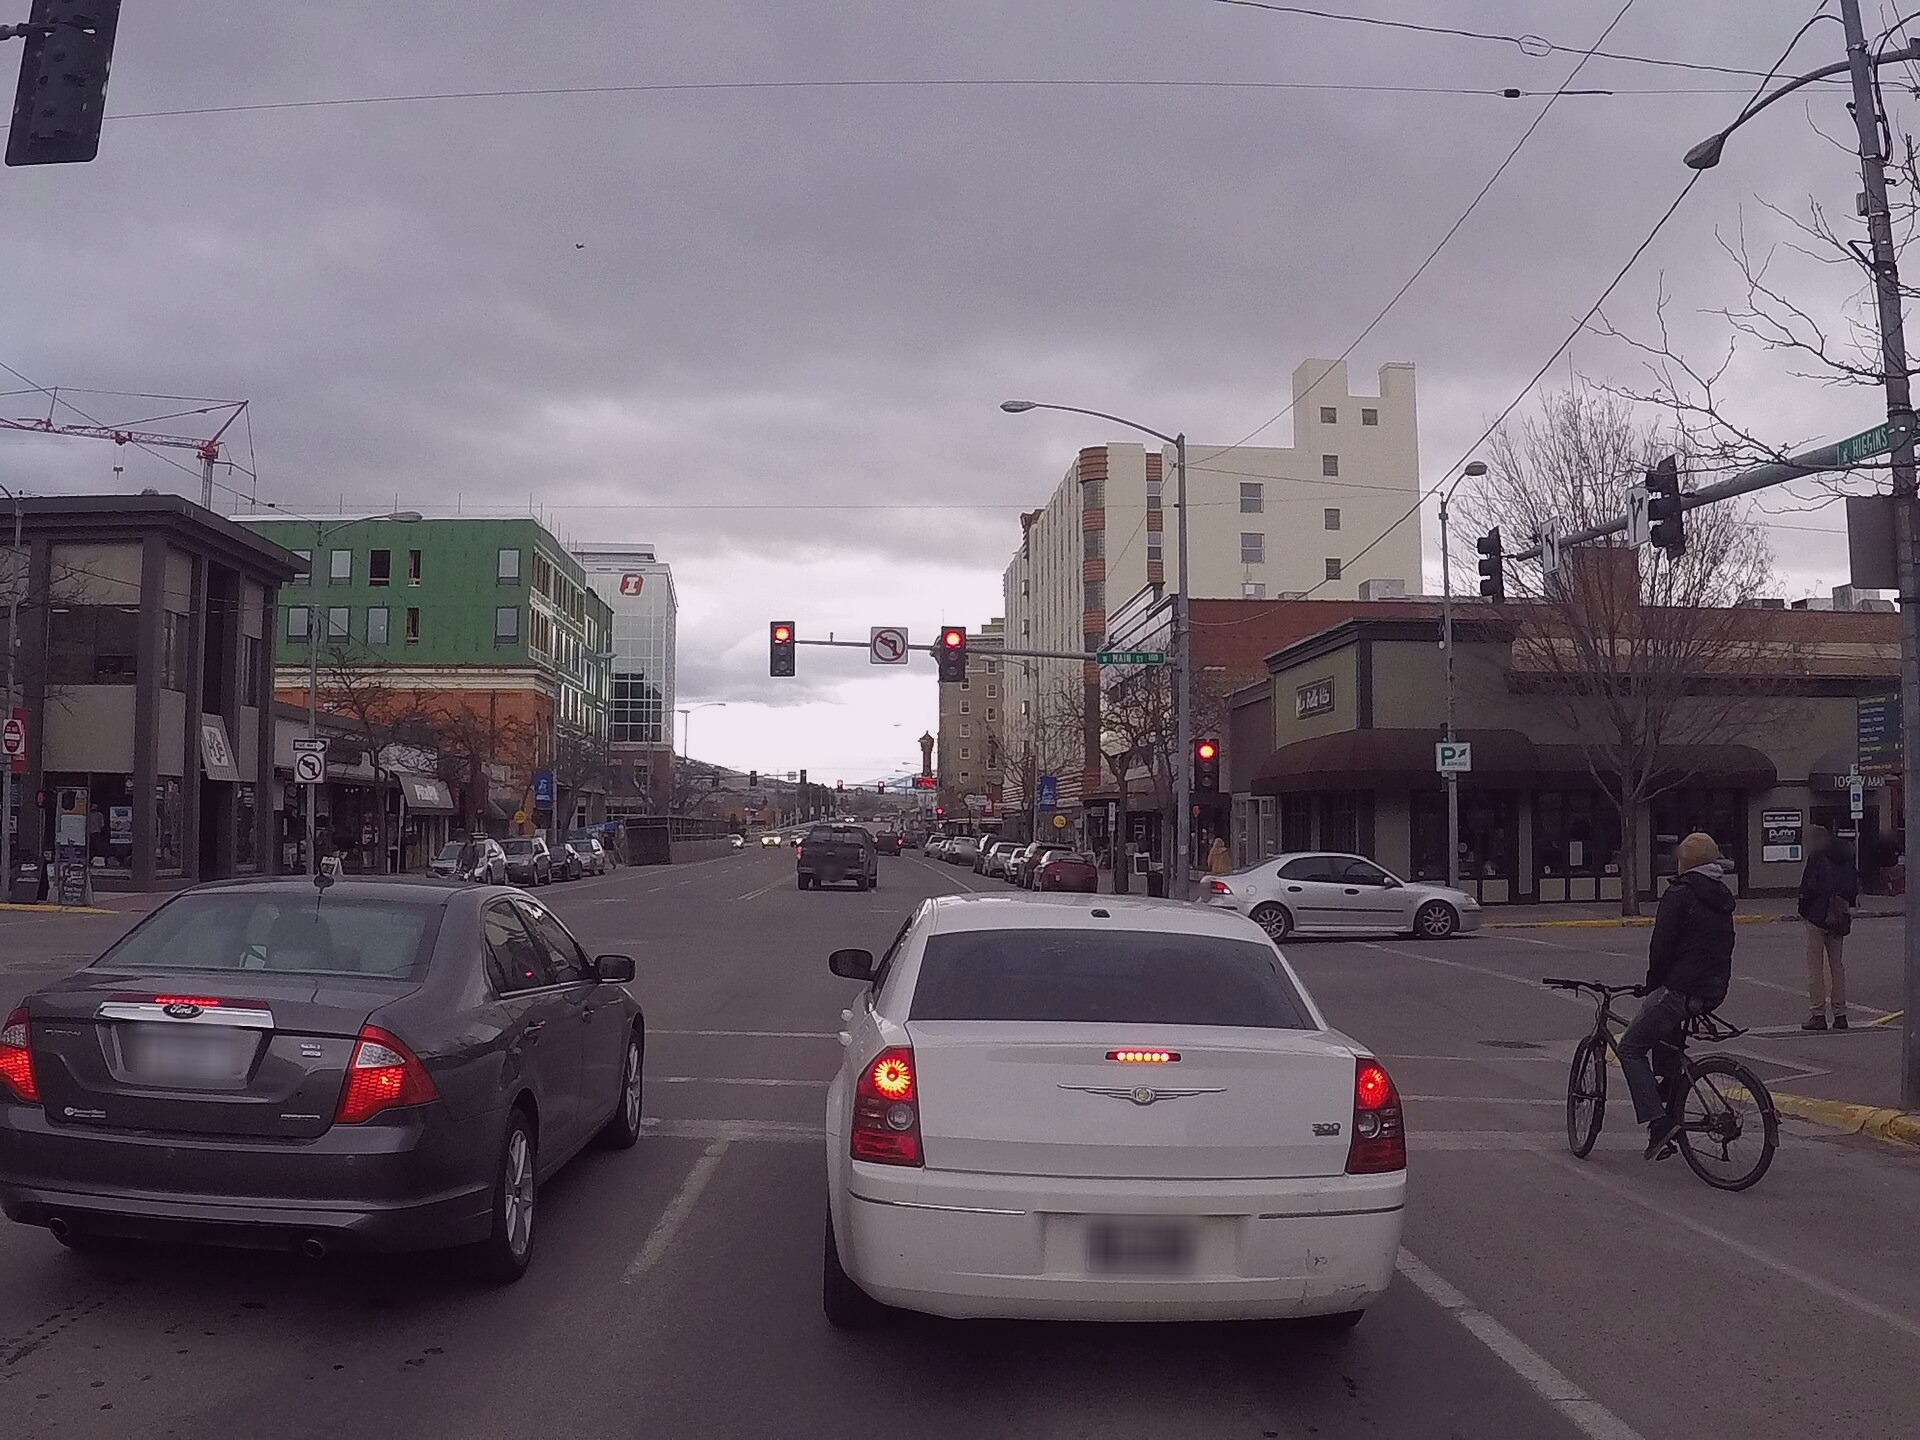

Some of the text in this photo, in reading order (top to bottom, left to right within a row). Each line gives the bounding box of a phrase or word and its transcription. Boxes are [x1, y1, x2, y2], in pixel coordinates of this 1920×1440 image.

[1852, 427, 1888, 457] HIGGINS
[1112, 654, 1131, 663] MAIN
[1136, 655, 1144, 663] ST
[169, 1004, 193, 1014] Ford
[1312, 1122, 1341, 1133] 300
